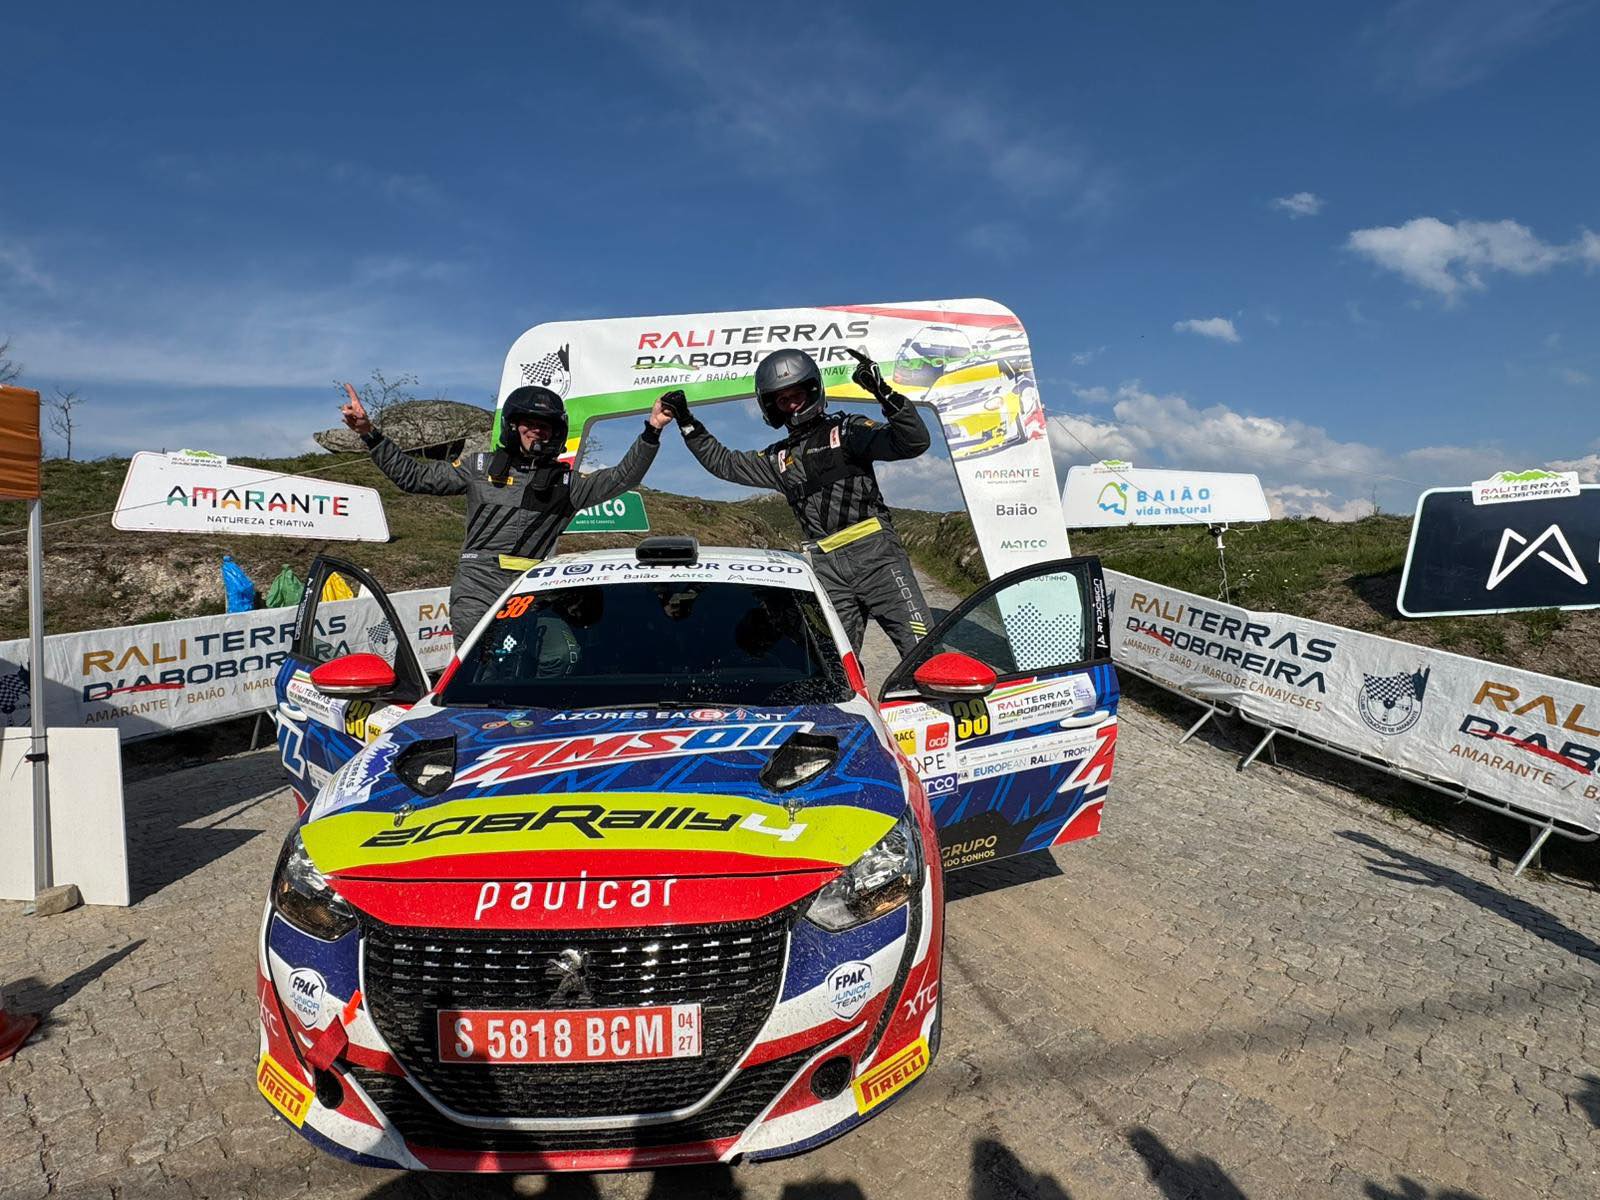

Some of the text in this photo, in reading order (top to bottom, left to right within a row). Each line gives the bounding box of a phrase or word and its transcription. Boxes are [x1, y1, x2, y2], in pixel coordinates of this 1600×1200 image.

[633, 374, 691, 386] AMARANTE
[975, 468, 1040, 479] AMARANTE
[167, 485, 349, 516] AMARANTE
[1136, 486, 1212, 502] BAIÃO
[996, 503, 1038, 516] Baião
[1136, 504, 1211, 516] vida natural
[206, 515, 315, 528] NATUREZA CRIATIVA
[728, 564, 803, 574] GOOD
[496, 595, 535, 619] 38
[84, 698, 168, 725] AMARANTE
[187, 685, 226, 704] BAIÃO
[1248, 680, 1323, 712] CANAVESES
[551, 711, 648, 721] AZORES
[954, 698, 989, 738] 38
[973, 758, 1027, 777] EUROPEAN
[1030, 751, 1060, 766] RALLY
[1062, 744, 1096, 758] TROPHY
[1449, 744, 1556, 786] AMARANTE
[961, 849, 996, 864] SONHOS
[292, 976, 319, 998] FPAK
[835, 967, 866, 991] FPAK
[290, 992, 320, 1011] JUNIOR
[831, 981, 871, 1003] JUNIOR
[836, 991, 867, 1009] TEAM
[293, 1000, 316, 1018] TEAM
[677, 1012, 694, 1030] 04
[454, 1014, 664, 1059] S 5818 BCM
[677, 1035, 693, 1051] 27
[861, 1044, 926, 1105] PIRELLI
[259, 1060, 305, 1118] PIRELLI
